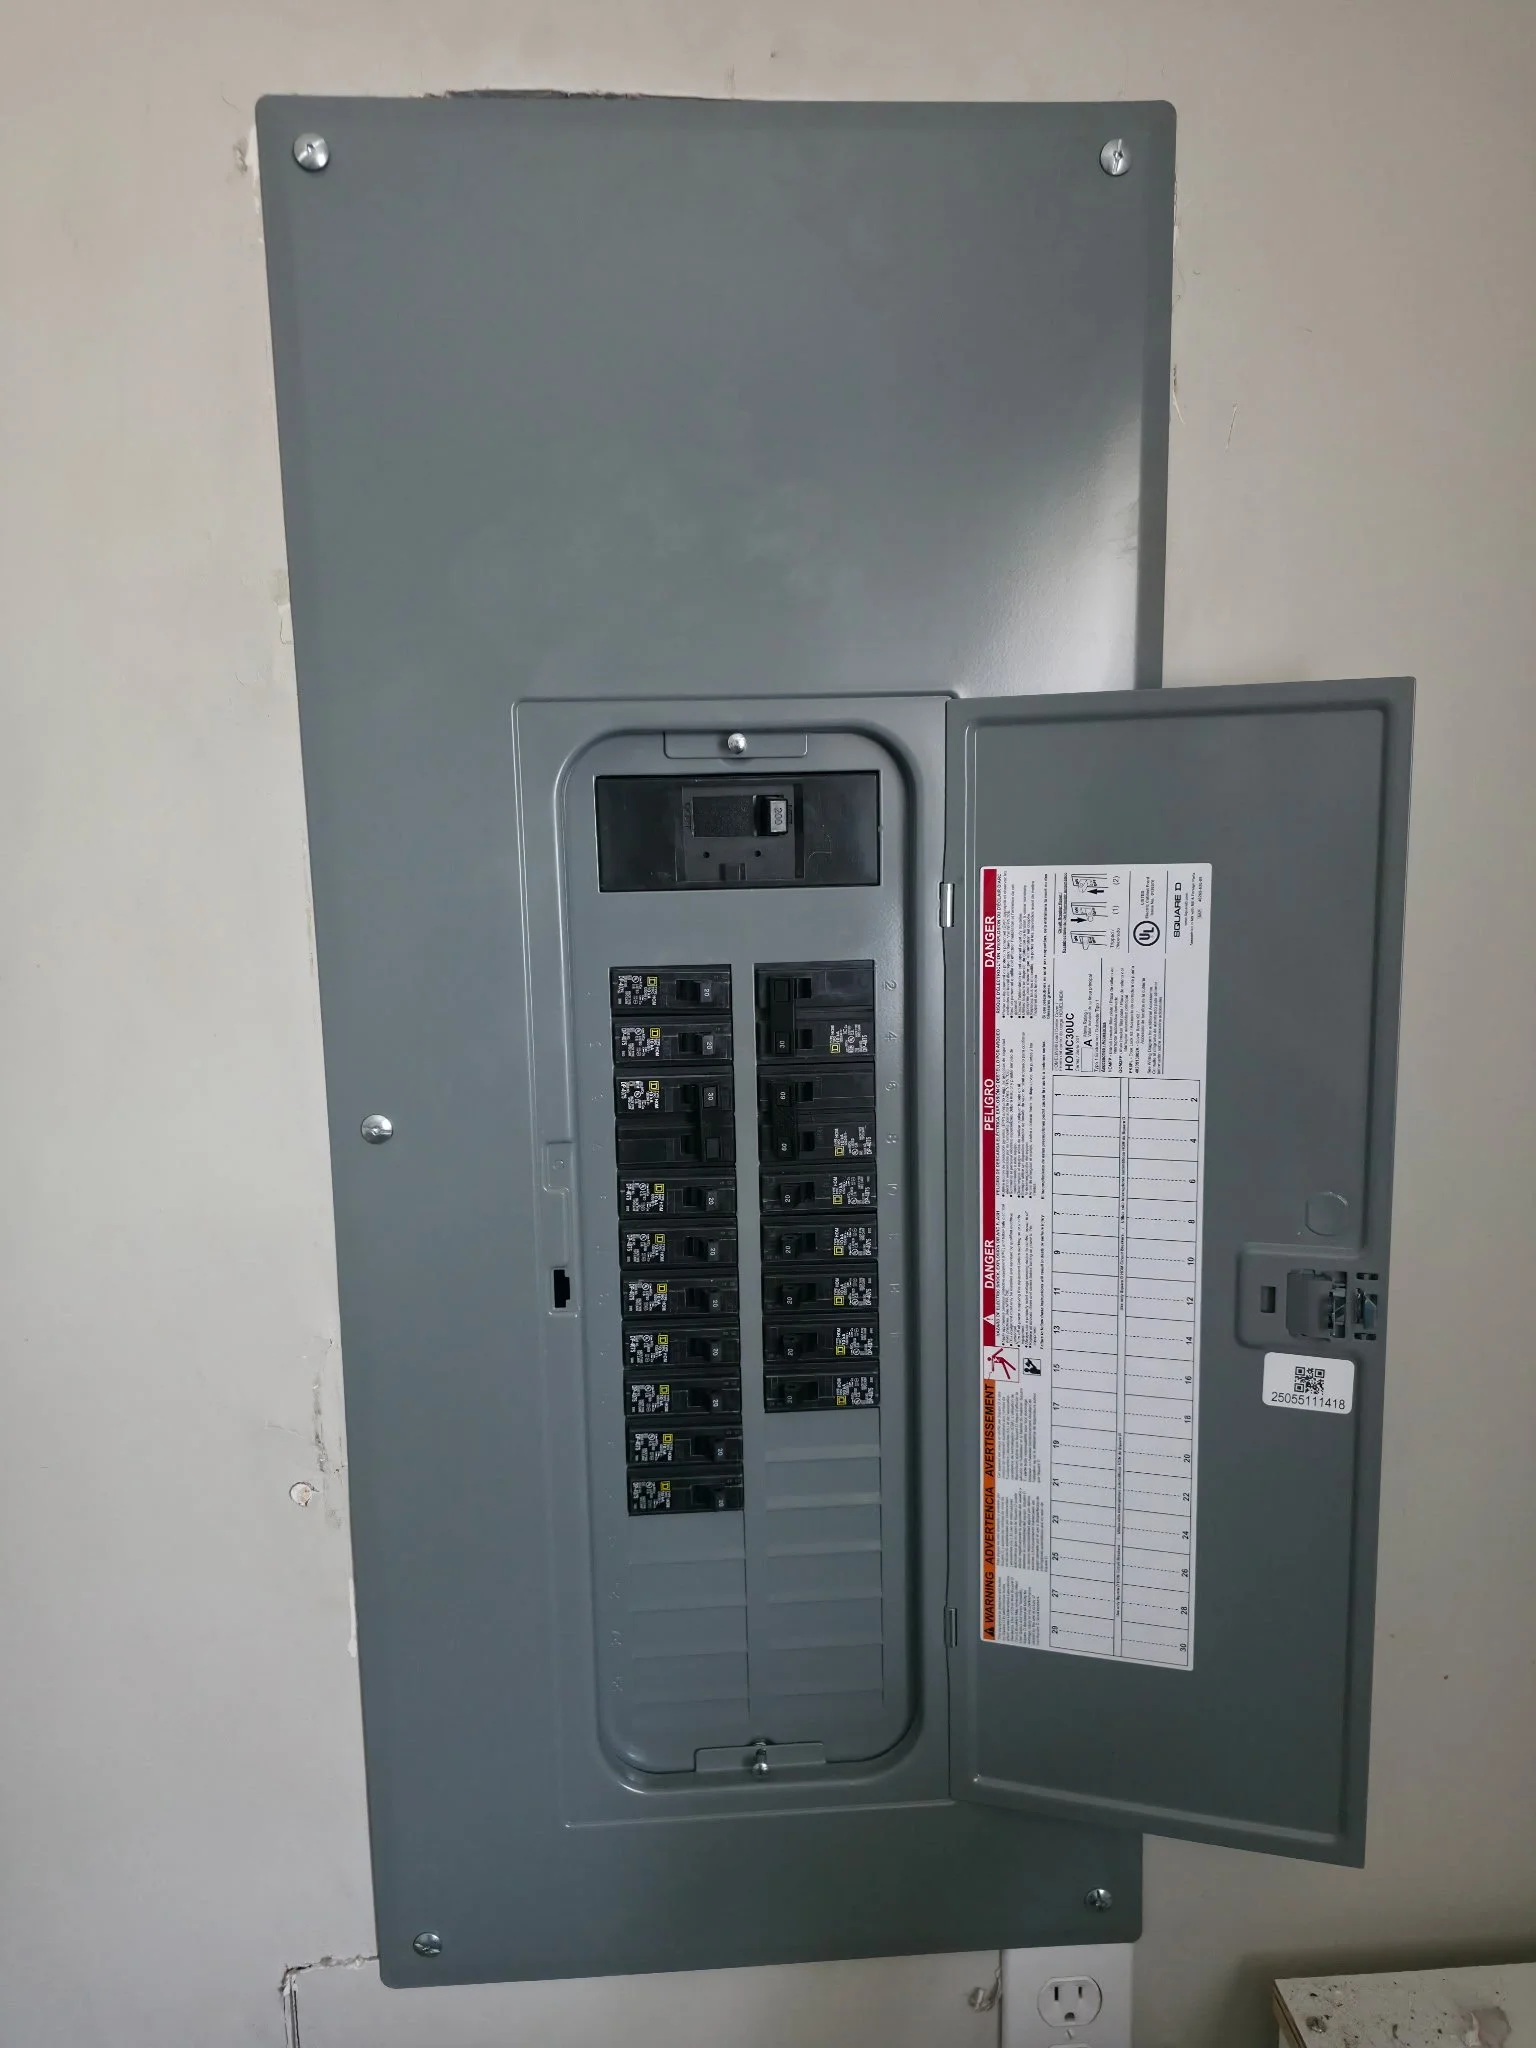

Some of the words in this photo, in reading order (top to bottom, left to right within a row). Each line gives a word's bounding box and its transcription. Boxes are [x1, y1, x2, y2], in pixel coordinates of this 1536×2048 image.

[774, 807, 783, 826] 200
[1112, 875, 1120, 886] (2)
[1174, 882, 1182, 891] D
[1173, 894, 1182, 938] SQUARE
[984, 915, 995, 968] DANGER
[884, 979, 898, 991] 2
[703, 988, 710, 997] 20
[884, 1031, 898, 1042] 4
[706, 1041, 713, 1050] 20
[779, 1040, 786, 1049] 30
[1065, 1012, 1074, 1071] HOMC30UC
[1083, 1039, 1093, 1047] A
[707, 1092, 714, 1101] 30
[780, 1091, 786, 1100] 60
[984, 1078, 994, 1131] PELIGRO
[781, 1143, 788, 1152] 60
[708, 1197, 715, 1206] 20
[785, 1194, 791, 1203] 20
[709, 1247, 716, 1256] 20
[785, 1245, 791, 1254] 20
[984, 1239, 995, 1289] DANGER
[1187, 1257, 1195, 1265] 10
[1053, 1287, 1060, 1296] 11
[712, 1299, 719, 1308] 20
[787, 1296, 793, 1305] 20
[1186, 1296, 1194, 1306] 12
[1053, 1325, 1060, 1334] 13
[1185, 1336, 1193, 1345] 14
[712, 1348, 719, 1357] 20
[787, 1348, 794, 1356] 20
[1053, 1363, 1060, 1373] 15
[1185, 1375, 1192, 1384] 16
[712, 1399, 719, 1408] 20
[787, 1395, 793, 1404] 20
[1271, 1391, 1346, 1410] 25055111418
[1053, 1401, 1060, 1411] 17
[1184, 1415, 1191, 1423] 18
[984, 1384, 995, 1477] AVERTISSEMENT
[1053, 1439, 1060, 1449] 19
[717, 1448, 723, 1456] 20
[1183, 1454, 1191, 1463] 20
[1052, 1478, 1059, 1487] 21
[1182, 1492, 1190, 1502] 22
[718, 1499, 725, 1507] 20
[1052, 1515, 1059, 1524] 23
[984, 1486, 995, 1565] ADVERTENCIA
[1182, 1531, 1189, 1540] 24
[1052, 1552, 1059, 1561] 25
[1181, 1568, 1188, 1577] 26
[984, 1571, 995, 1623] WARNING
[1052, 1589, 1059, 1598] 27
[1180, 1606, 1187, 1615] 28
[1051, 1625, 1058, 1634] 29
[1179, 1643, 1187, 1652] 30
